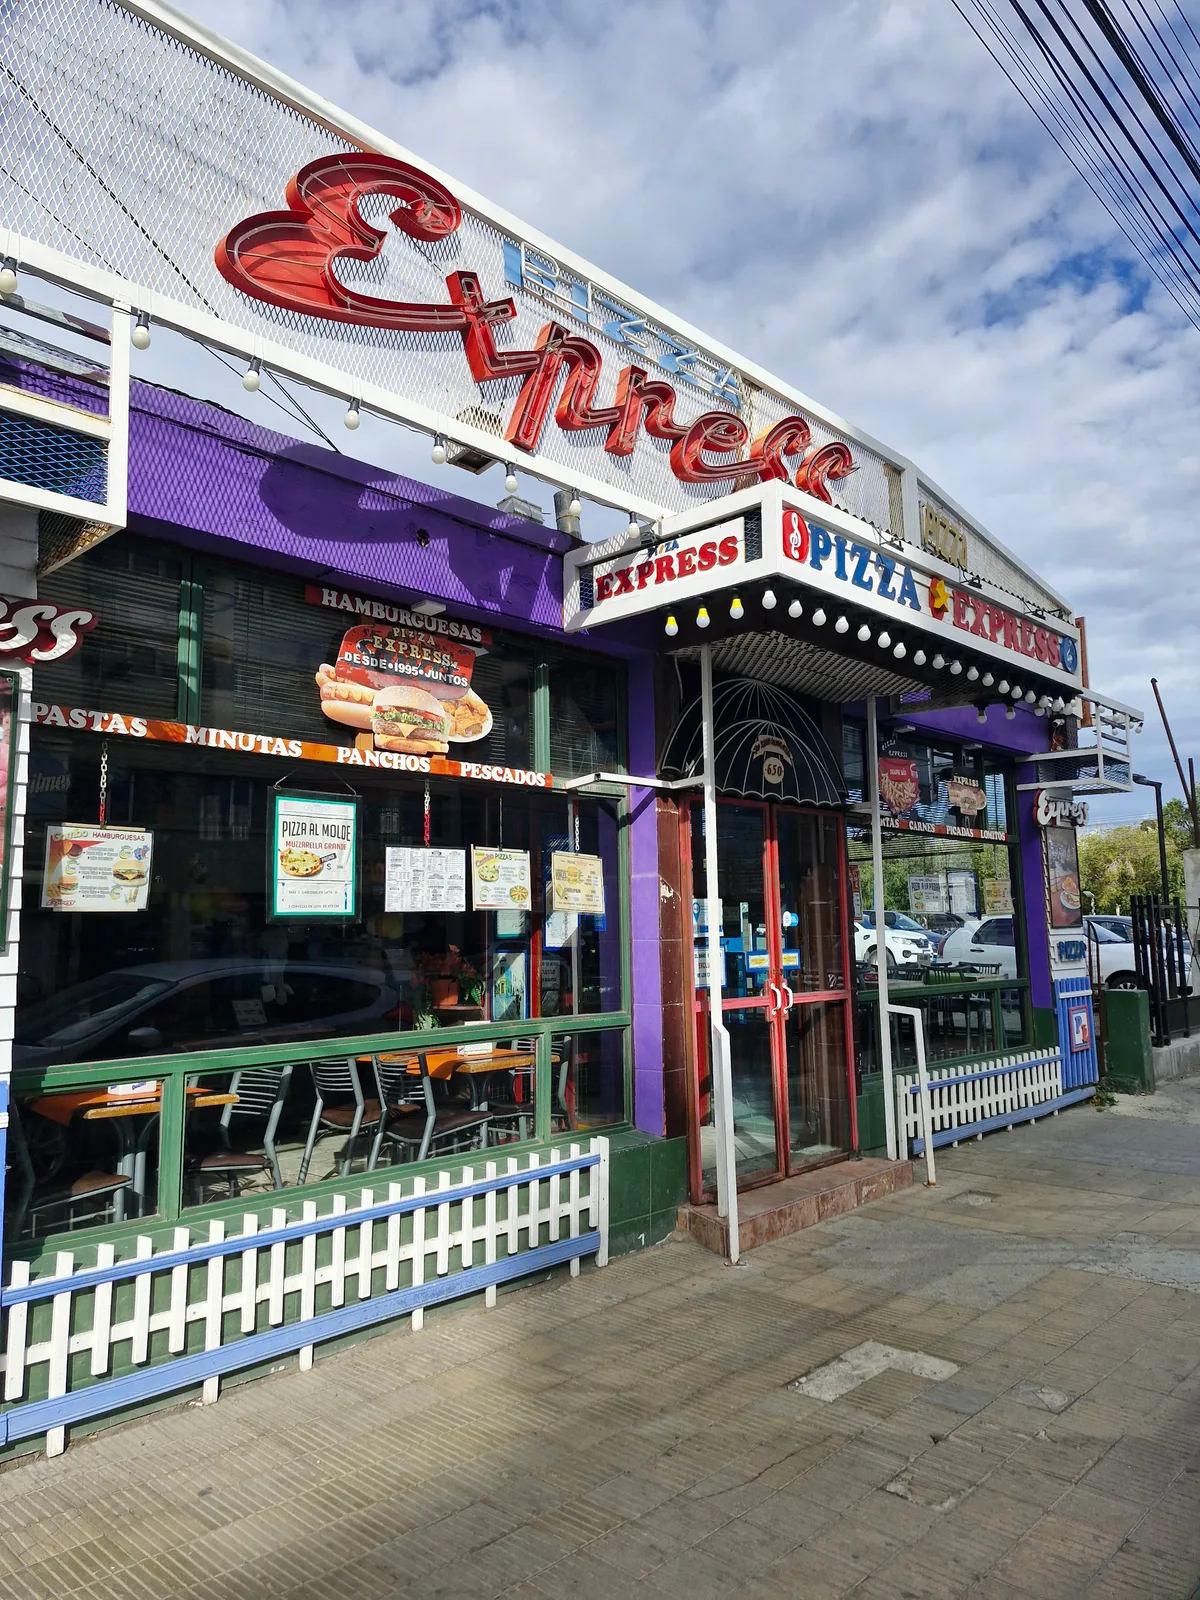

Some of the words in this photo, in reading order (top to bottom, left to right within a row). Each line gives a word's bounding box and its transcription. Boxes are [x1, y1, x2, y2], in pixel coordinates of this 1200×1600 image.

[595, 535, 739, 602] EXPRESS
[807, 522, 922, 612] PIZZA
[952, 590, 1061, 667] EXPRESS
[321, 588, 482, 642] HAMBURGUESAS
[392, 627, 435, 645] PIZZA
[372, 635, 451, 667] EXPRESS
[31, 701, 148, 738] PASTAS
[185, 725, 303, 758] MINUTAS
[336, 746, 431, 773] PANCHOS
[460, 762, 546, 787] PESCADOS
[766, 763, 783, 777] 650
[1036, 789, 1090, 827] Express
[92, 832, 145, 842] HAMBURGUESAS
[282, 820, 307, 838] PIZZA
[309, 822, 319, 836] AL
[322, 823, 351, 841] MOLDE
[908, 821, 935, 833] CARNES
[946, 827, 974, 838] PICADAS
[980, 830, 1006, 841] LOMITOS
[285, 840, 323, 850] MUZZARELLA
[324, 842, 347, 851] GRANDE
[494, 853, 513, 861] PIZZAS
[1057, 940, 1087, 960] PIZZA
